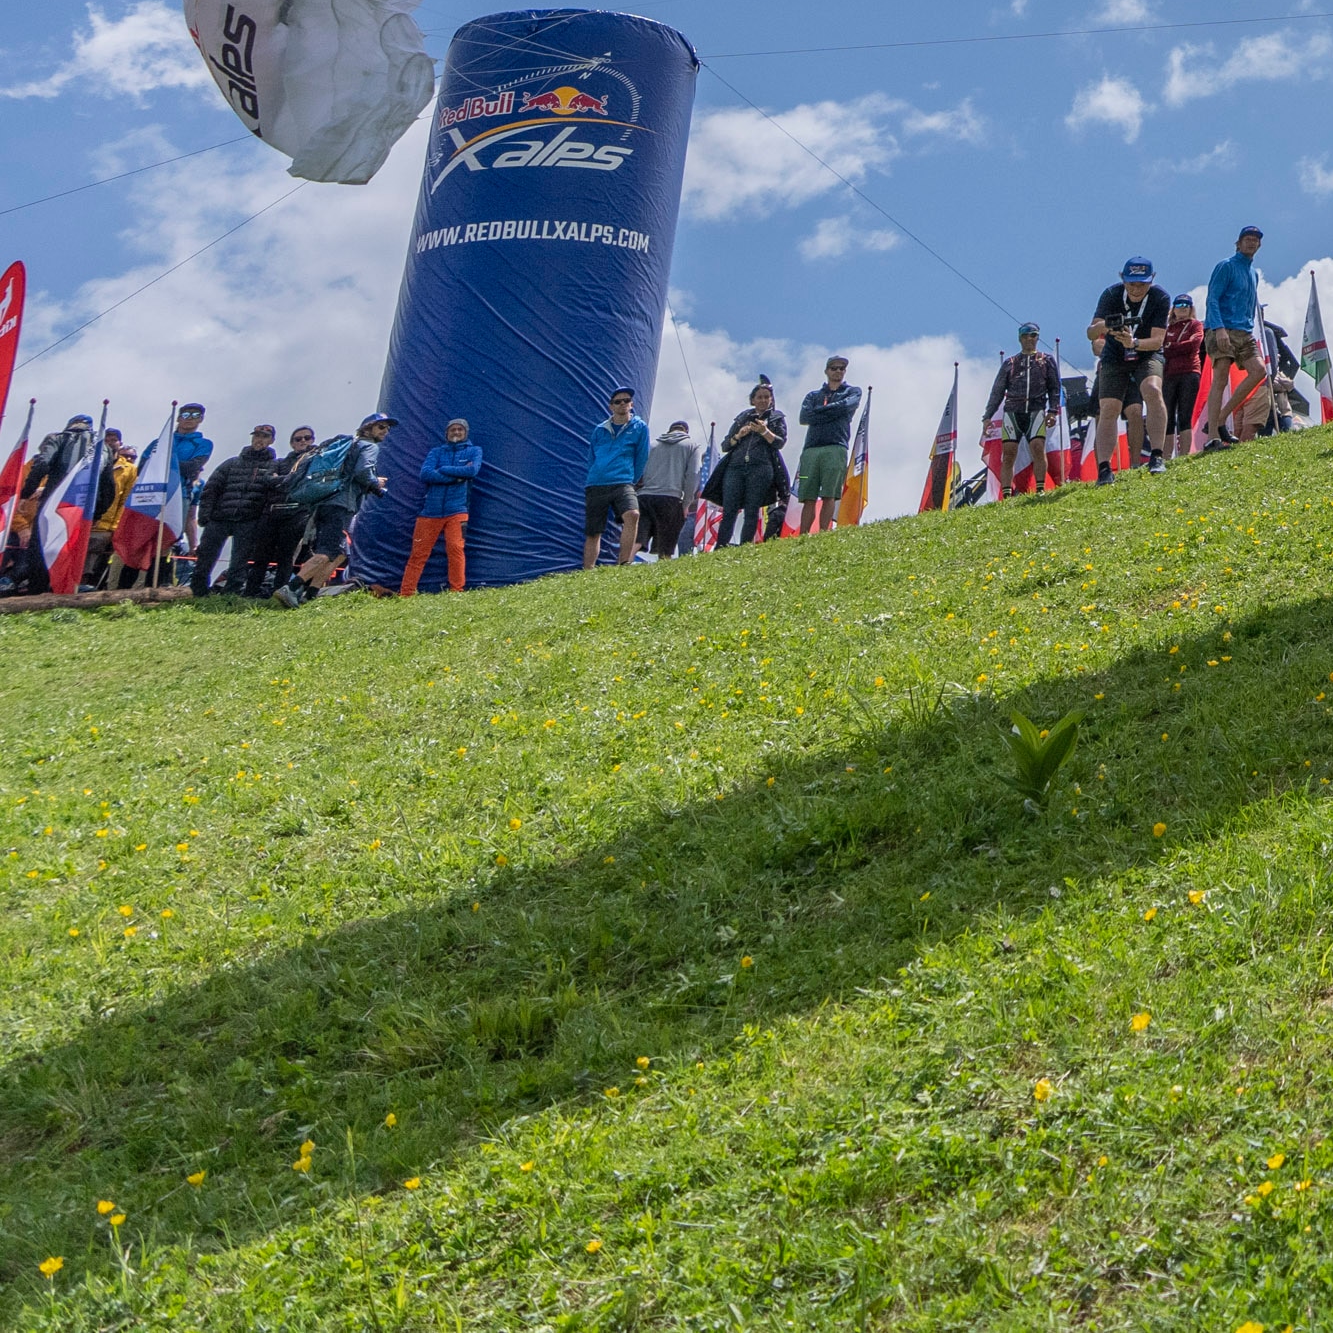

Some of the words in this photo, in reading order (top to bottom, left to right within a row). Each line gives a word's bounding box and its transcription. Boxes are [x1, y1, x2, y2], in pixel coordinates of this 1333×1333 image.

[439, 99, 470, 130] Red
[468, 90, 516, 119] Bull
[416, 220, 650, 254] WWW.REDBULLXALPS.COM
